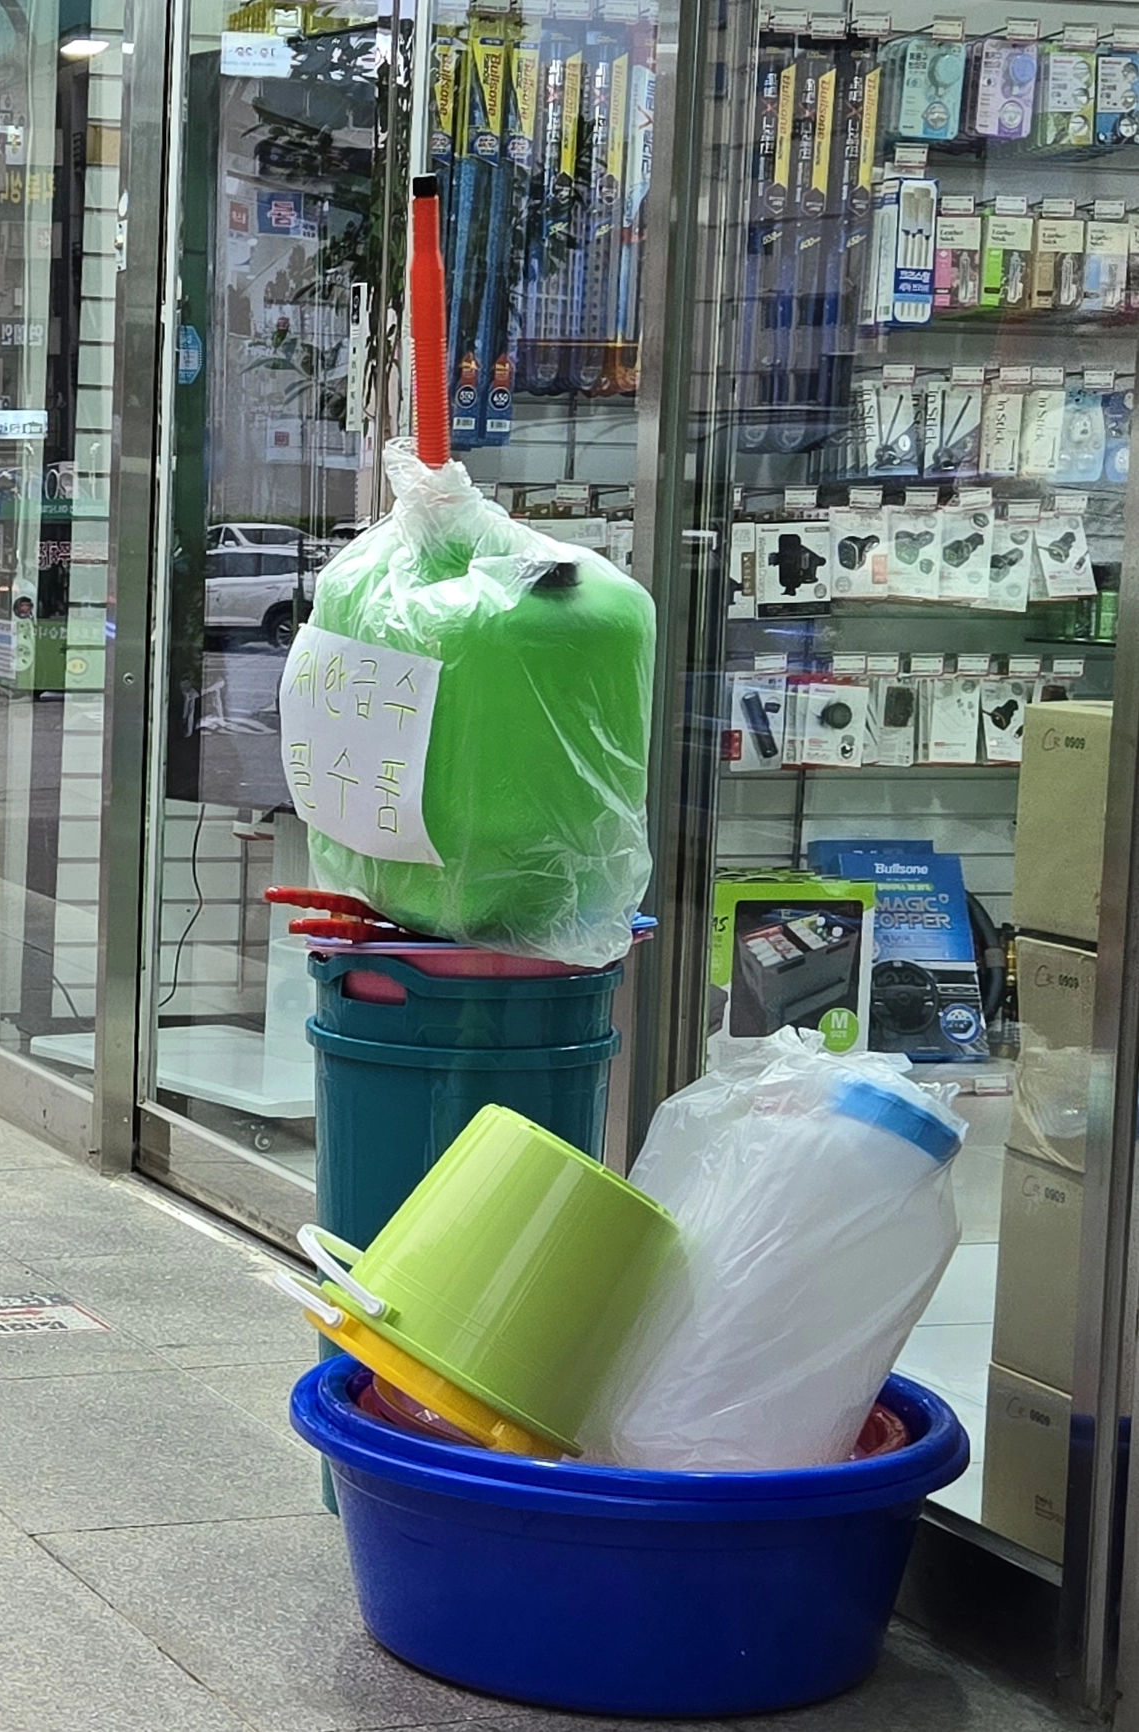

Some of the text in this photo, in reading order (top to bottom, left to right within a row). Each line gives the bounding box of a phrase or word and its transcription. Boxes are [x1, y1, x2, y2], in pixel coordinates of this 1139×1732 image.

[487, 52, 502, 117] Bullsone
[778, 74, 791, 135] Bullsone
[816, 79, 831, 141] Bullsone
[862, 77, 876, 139] Bullsone
[289, 645, 417, 731] 제한급수
[290, 739, 406, 833] 필수품
[874, 862, 929, 875] Bullsone
[875, 895, 939, 912] MAGIC
[831, 1011, 849, 1029] M
